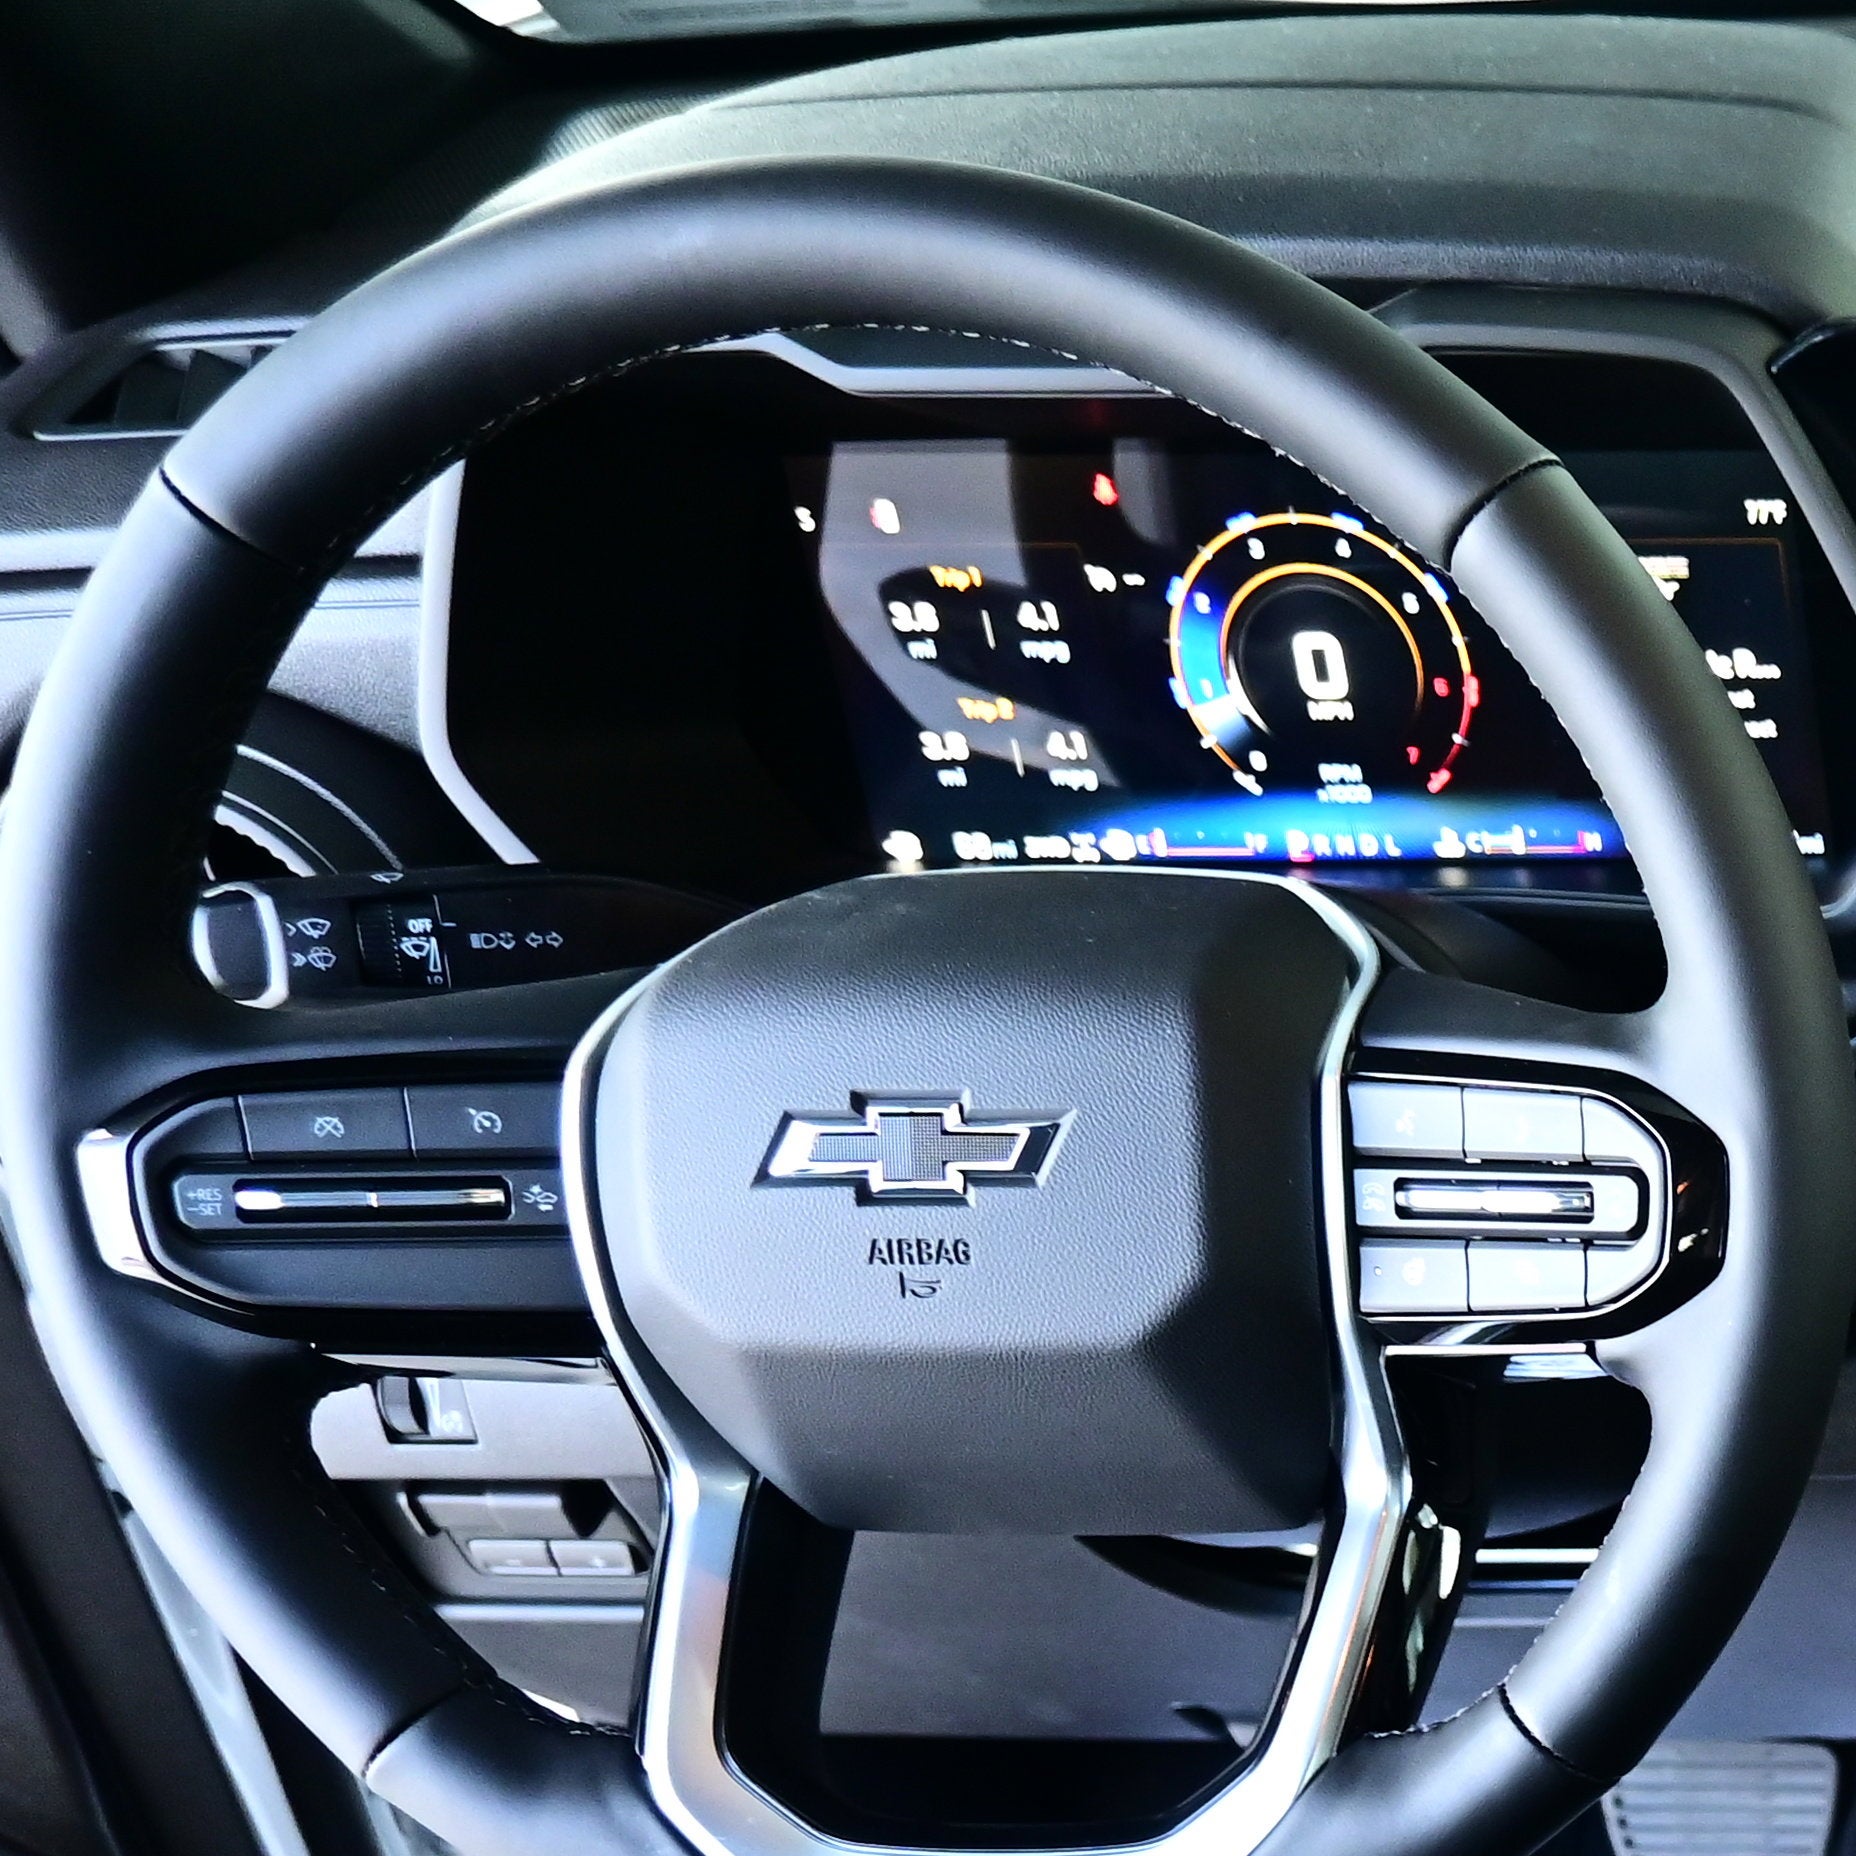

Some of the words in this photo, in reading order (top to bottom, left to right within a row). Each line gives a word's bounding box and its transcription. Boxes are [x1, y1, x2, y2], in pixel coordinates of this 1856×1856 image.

[1291, 630, 1350, 701] 0
[1306, 700, 1355, 722] MPH
[407, 917, 433, 934] OFF
[868, 1237, 972, 1266] AIRBAG
